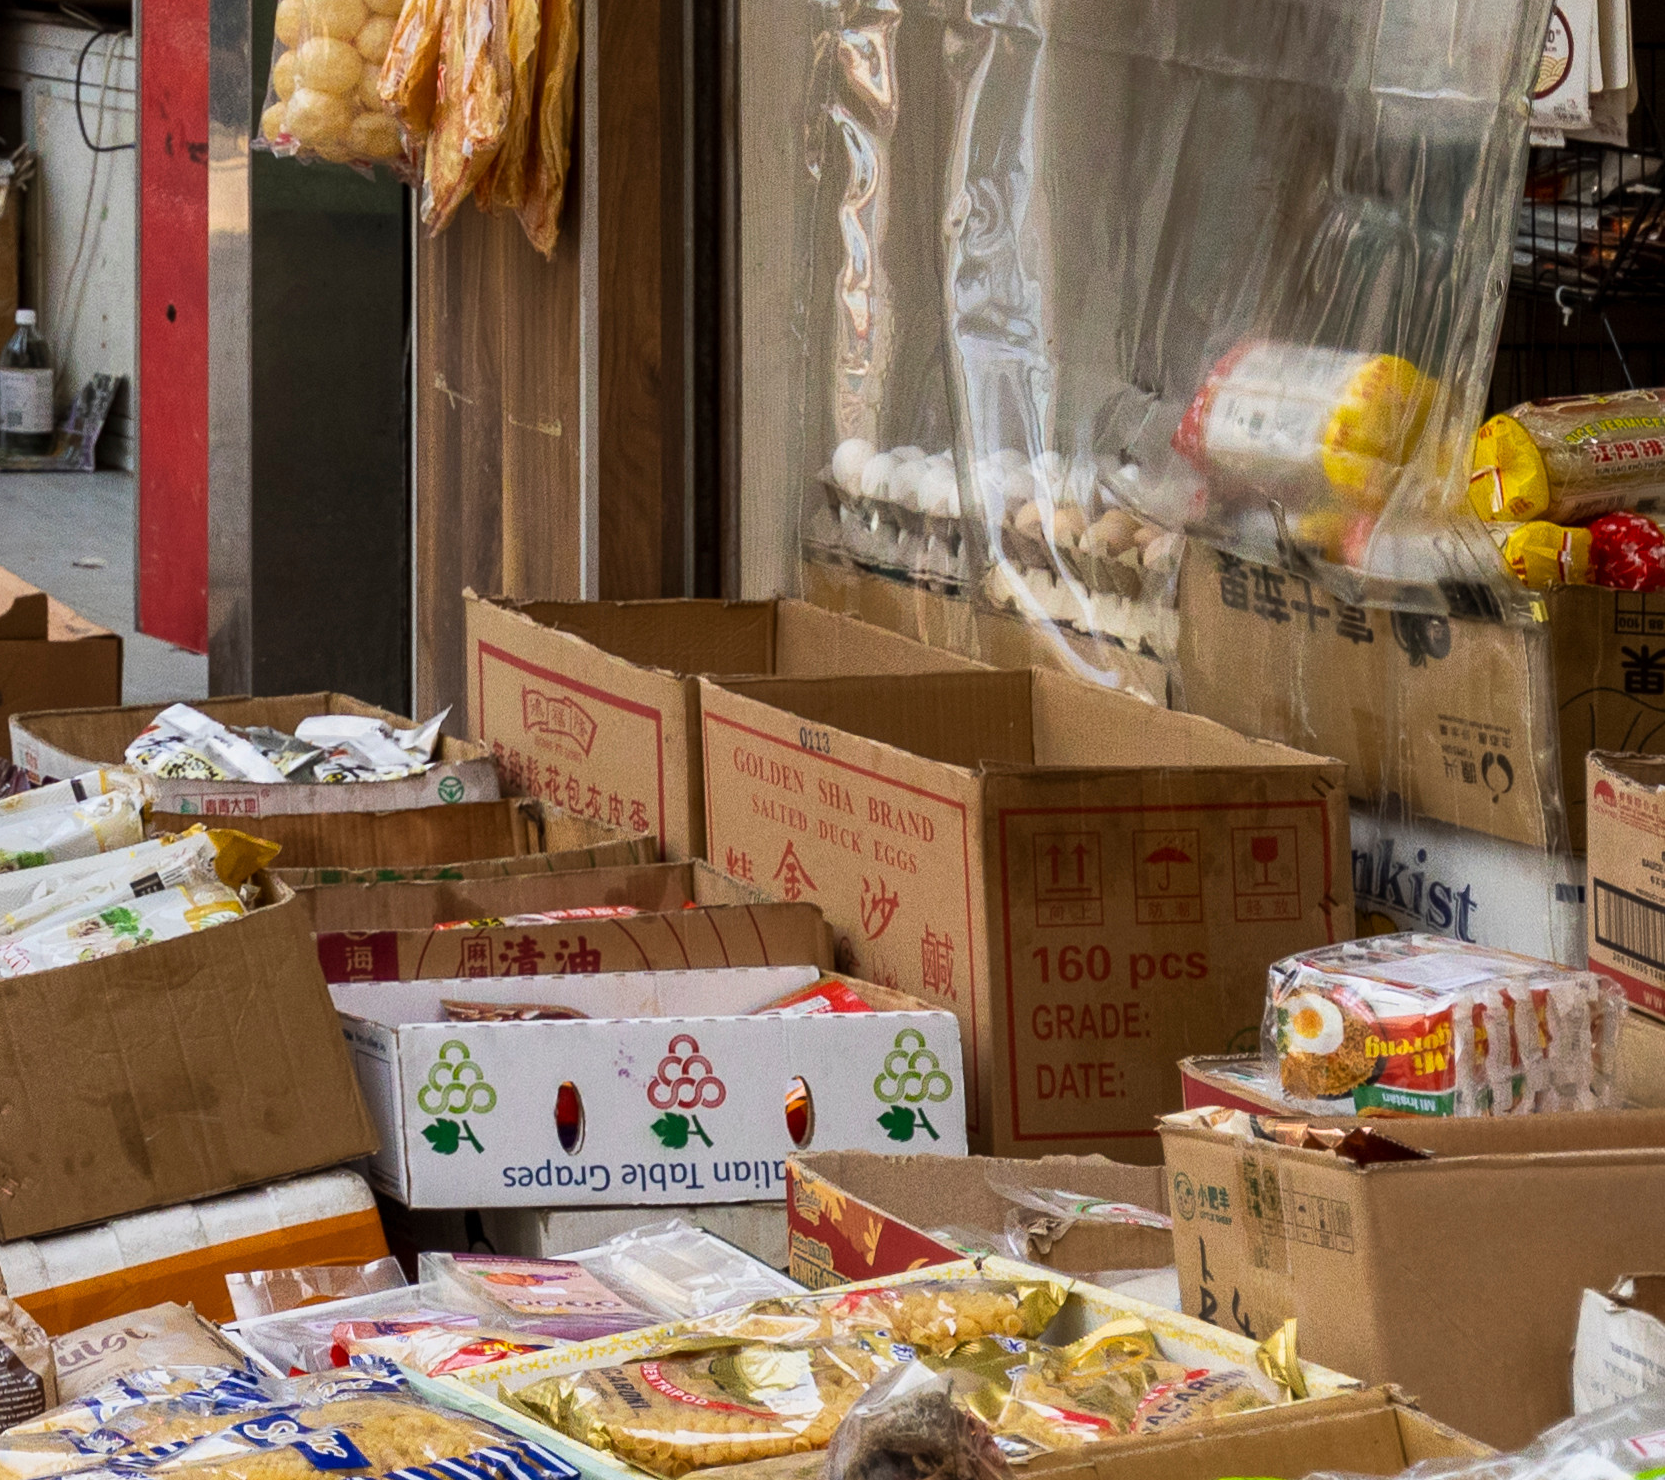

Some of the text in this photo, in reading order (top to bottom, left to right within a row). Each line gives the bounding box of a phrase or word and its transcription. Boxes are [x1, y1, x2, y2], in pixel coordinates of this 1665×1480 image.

[1597, 415, 1665, 432] VERMICE
[1617, 617, 1641, 634] 100
[799, 726, 831, 755] 0113
[732, 745, 936, 844] GOLDEN SHA BRAND
[750, 790, 919, 877] SALTED DUCK EGGS
[1352, 839, 1479, 942] nkist
[1031, 943, 1211, 991] 160 pcs
[1031, 1001, 1153, 1041] GRADE:
[1363, 1022, 1452, 1061] goreng
[1035, 1062, 1128, 1100] DATE:
[1413, 1051, 1448, 1077] Mi
[502, 1159, 788, 1193] alian Table Grapes
